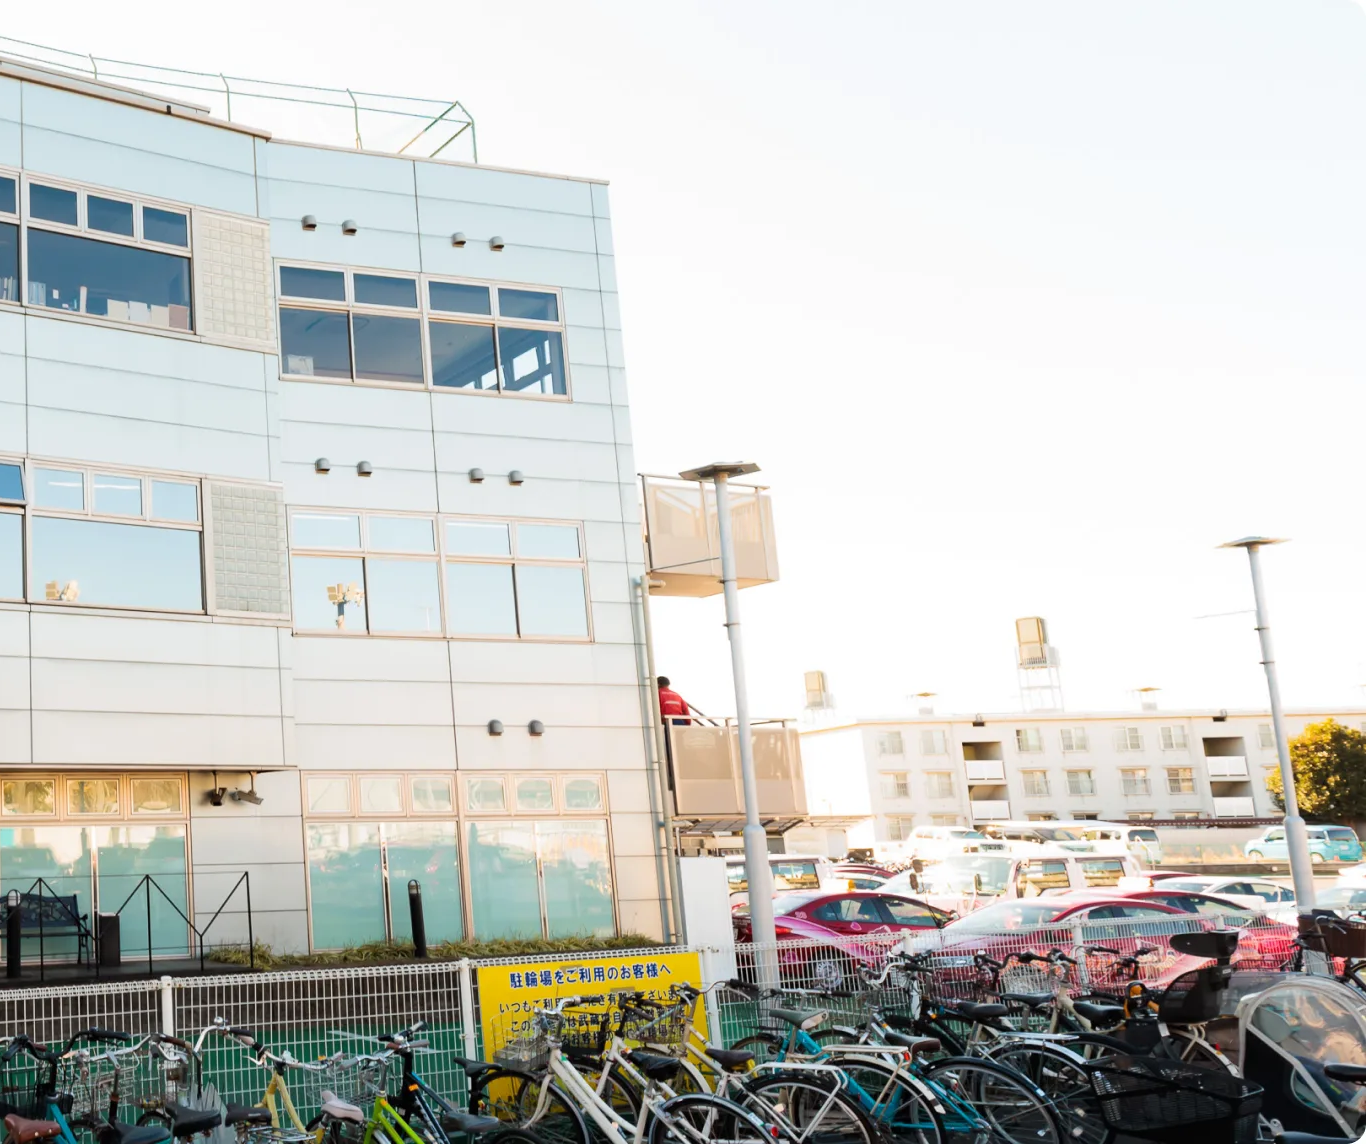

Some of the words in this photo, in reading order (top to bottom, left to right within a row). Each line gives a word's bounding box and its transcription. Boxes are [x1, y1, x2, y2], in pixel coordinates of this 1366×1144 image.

[509, 962, 672, 989] 駐輪場をご利用のお客様へ
